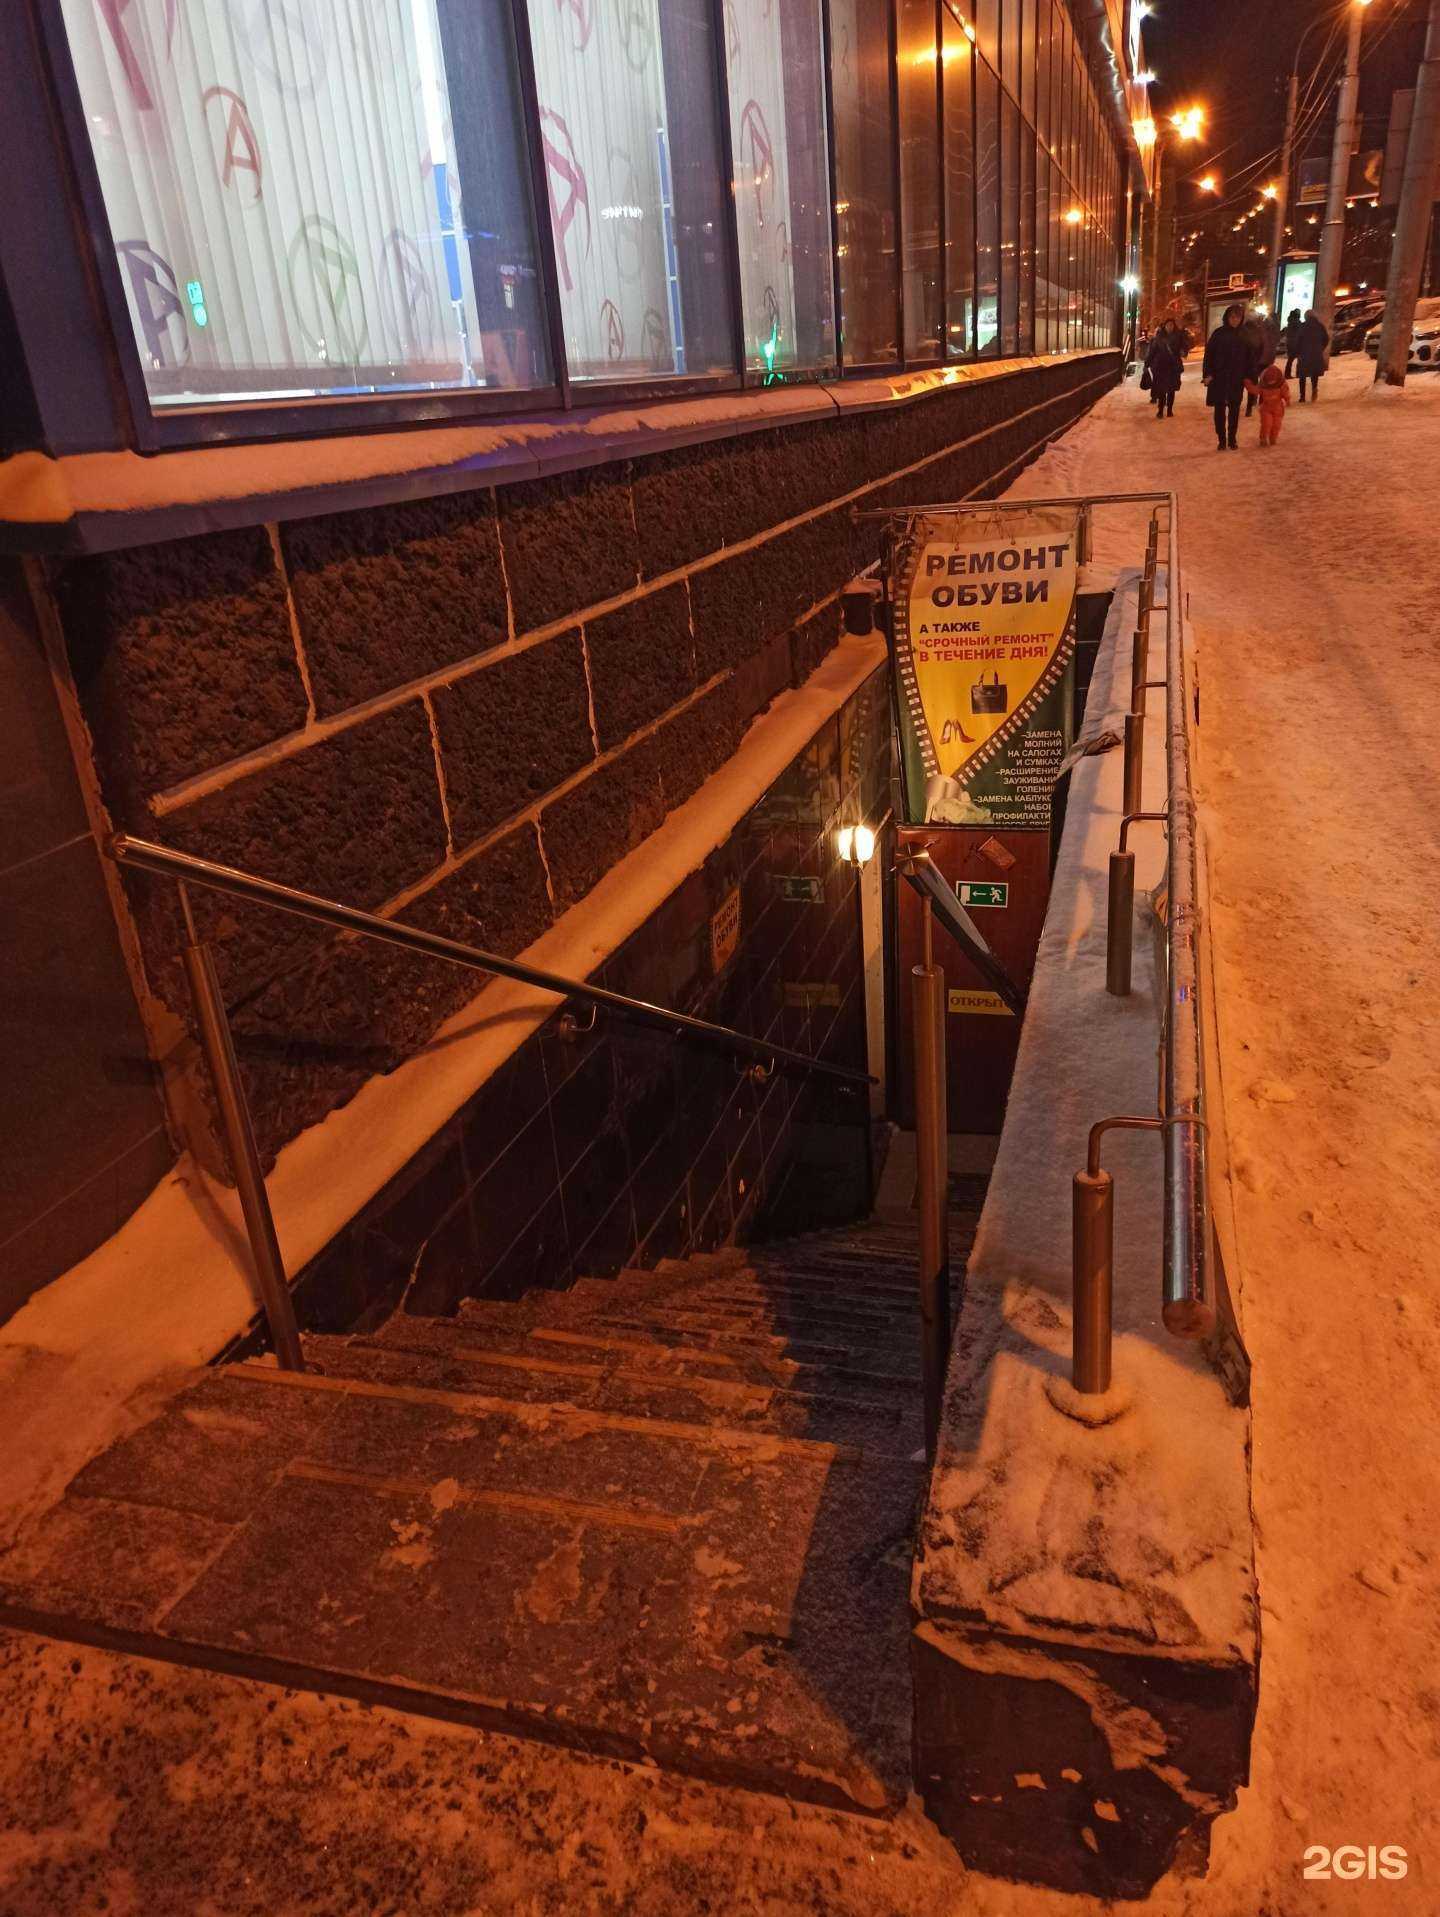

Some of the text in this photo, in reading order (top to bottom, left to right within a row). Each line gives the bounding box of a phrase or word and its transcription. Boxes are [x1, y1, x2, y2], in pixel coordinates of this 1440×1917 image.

[926, 544, 1070, 577] РЕМОНТ
[931, 580, 1049, 608] ОБУВИ
[919, 621, 980, 634] А ТАКЖЕ
[919, 646, 1048, 662] В ТЕЧЕНИЕ ДНЯ!
[1024, 739, 1062, 748] МОЛНИЙ
[1007, 748, 1062, 757] НА САПОГАХ
[1016, 758, 1022, 766] И
